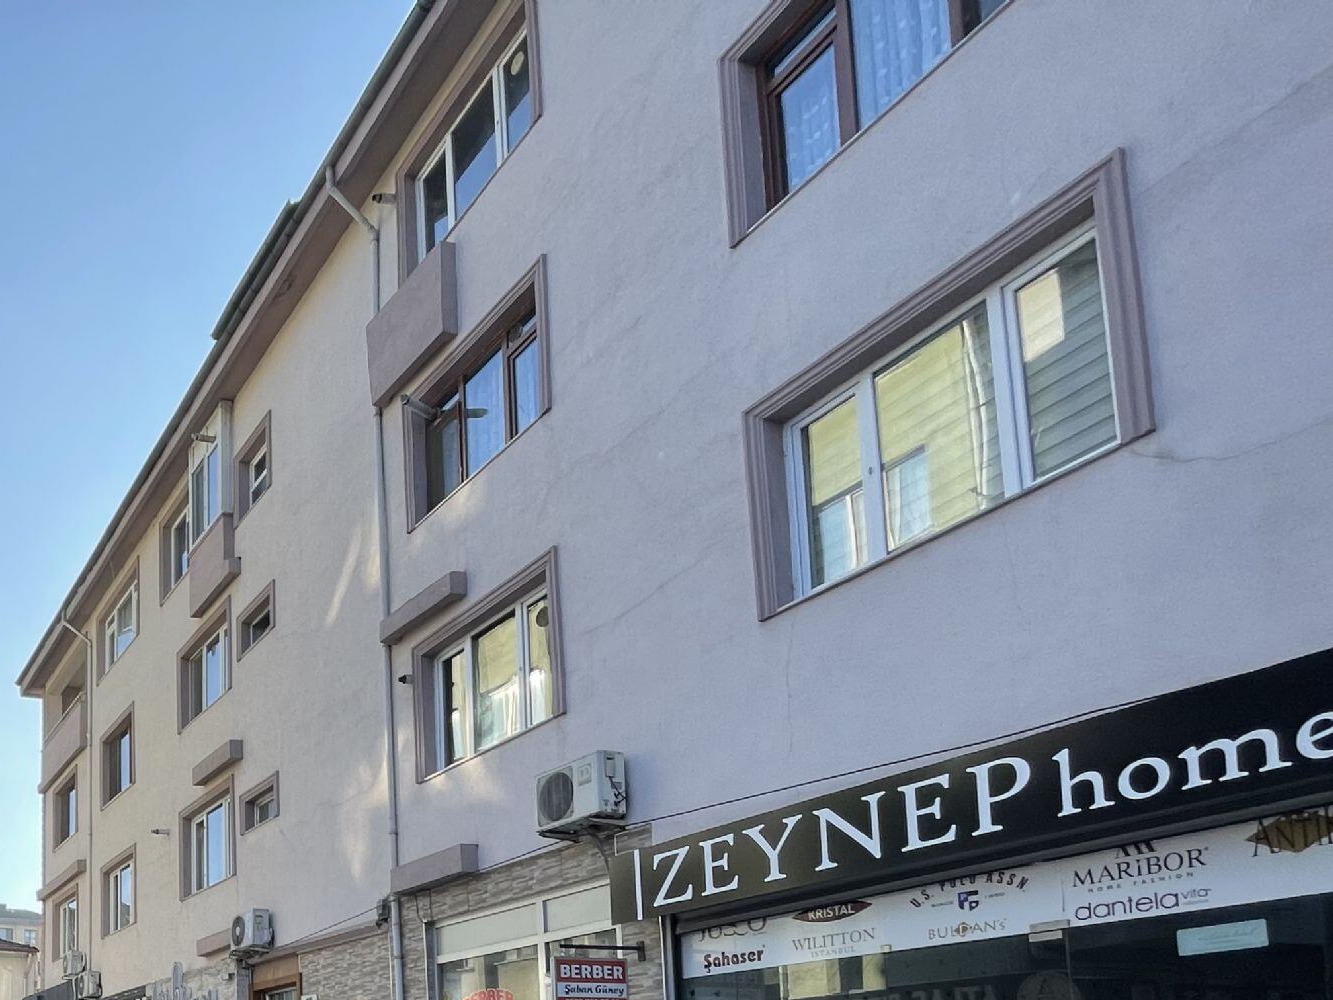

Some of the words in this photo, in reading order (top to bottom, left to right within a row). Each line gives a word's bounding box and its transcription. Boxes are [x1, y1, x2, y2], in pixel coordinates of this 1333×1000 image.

[653, 756, 1032, 908] ZEYNEP
[1057, 710, 1333, 818] home
[808, 904, 856, 920] KRISTAL
[1075, 892, 1180, 920] dantela
[792, 927, 875, 951] WILITTON
[560, 964, 623, 979] BERBER
[704, 950, 764, 973] Şahaser
[565, 984, 593, 995] Şaban
[595, 984, 625, 997] Güney
